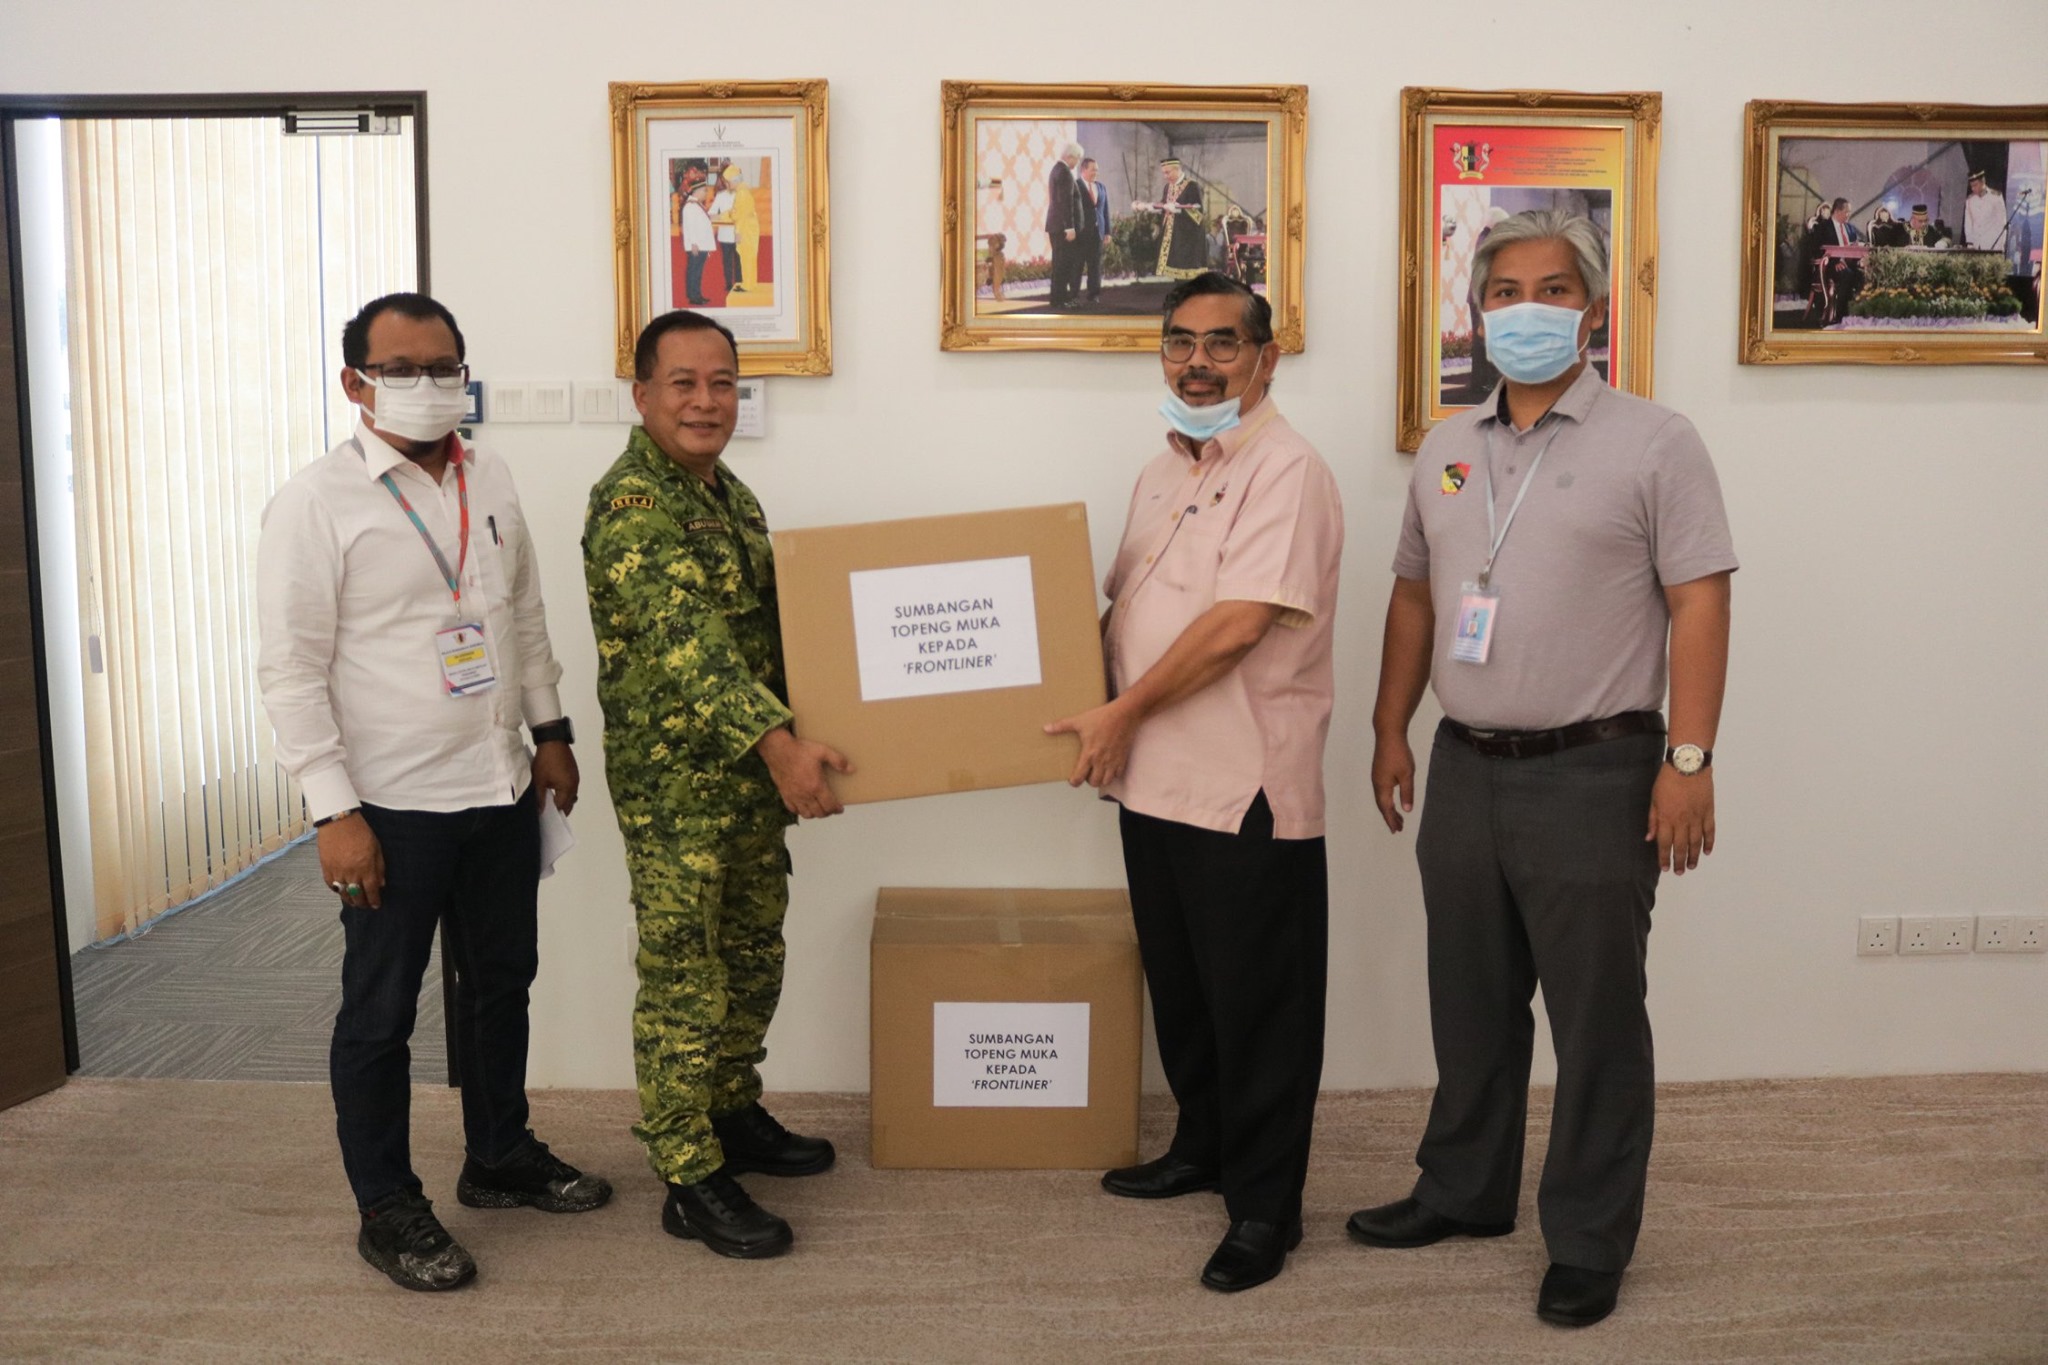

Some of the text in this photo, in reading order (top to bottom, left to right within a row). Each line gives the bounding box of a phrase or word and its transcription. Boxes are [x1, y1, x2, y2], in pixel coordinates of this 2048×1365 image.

[895, 598, 994, 619] SUMBANGAN
[891, 616, 1001, 638] TOPENG MUKA
[918, 638, 978, 654] KEPADA
[968, 1033, 1054, 1045] SUMBANGAN
[964, 1048, 1059, 1060] TOPENG MUKA
[986, 1064, 1037, 1075] KEPADA
